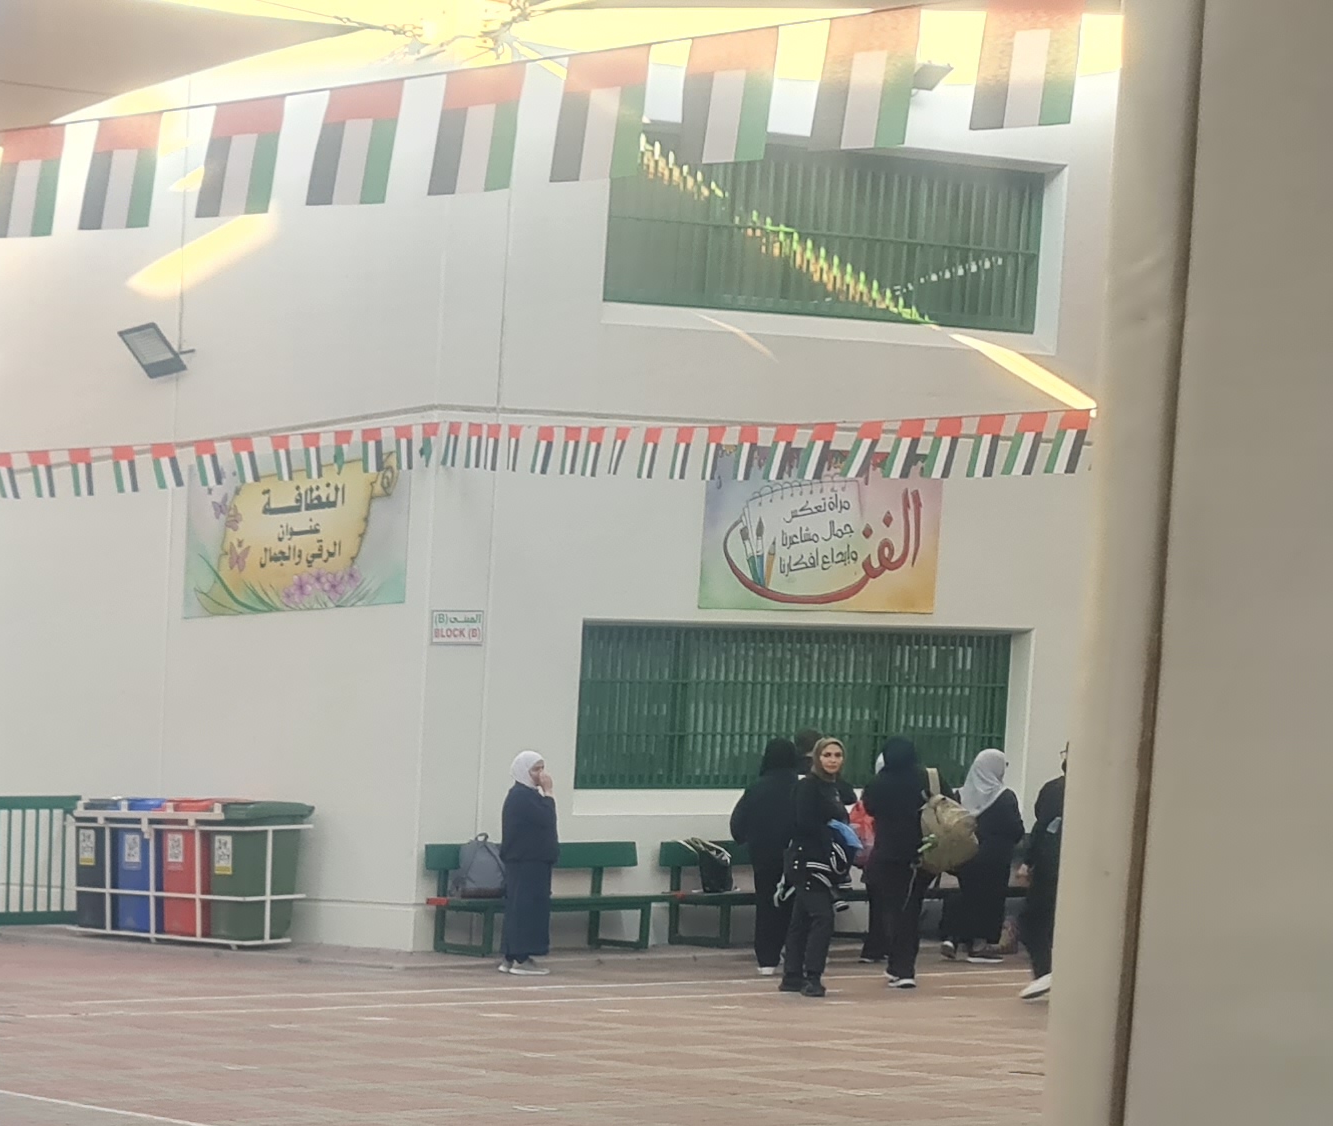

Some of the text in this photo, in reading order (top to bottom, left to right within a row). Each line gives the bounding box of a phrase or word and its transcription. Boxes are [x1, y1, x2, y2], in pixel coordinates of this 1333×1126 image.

[261, 482, 345, 515] النظافة
[783, 497, 827, 523] تعكس
[277, 517, 321, 542] عنوان
[781, 520, 855, 549] جمال مشاعرنا
[259, 539, 341, 568] الرقي والجمال
[723, 488, 922, 604] الفن
[434, 627, 482, 640] BLOCK (B)
